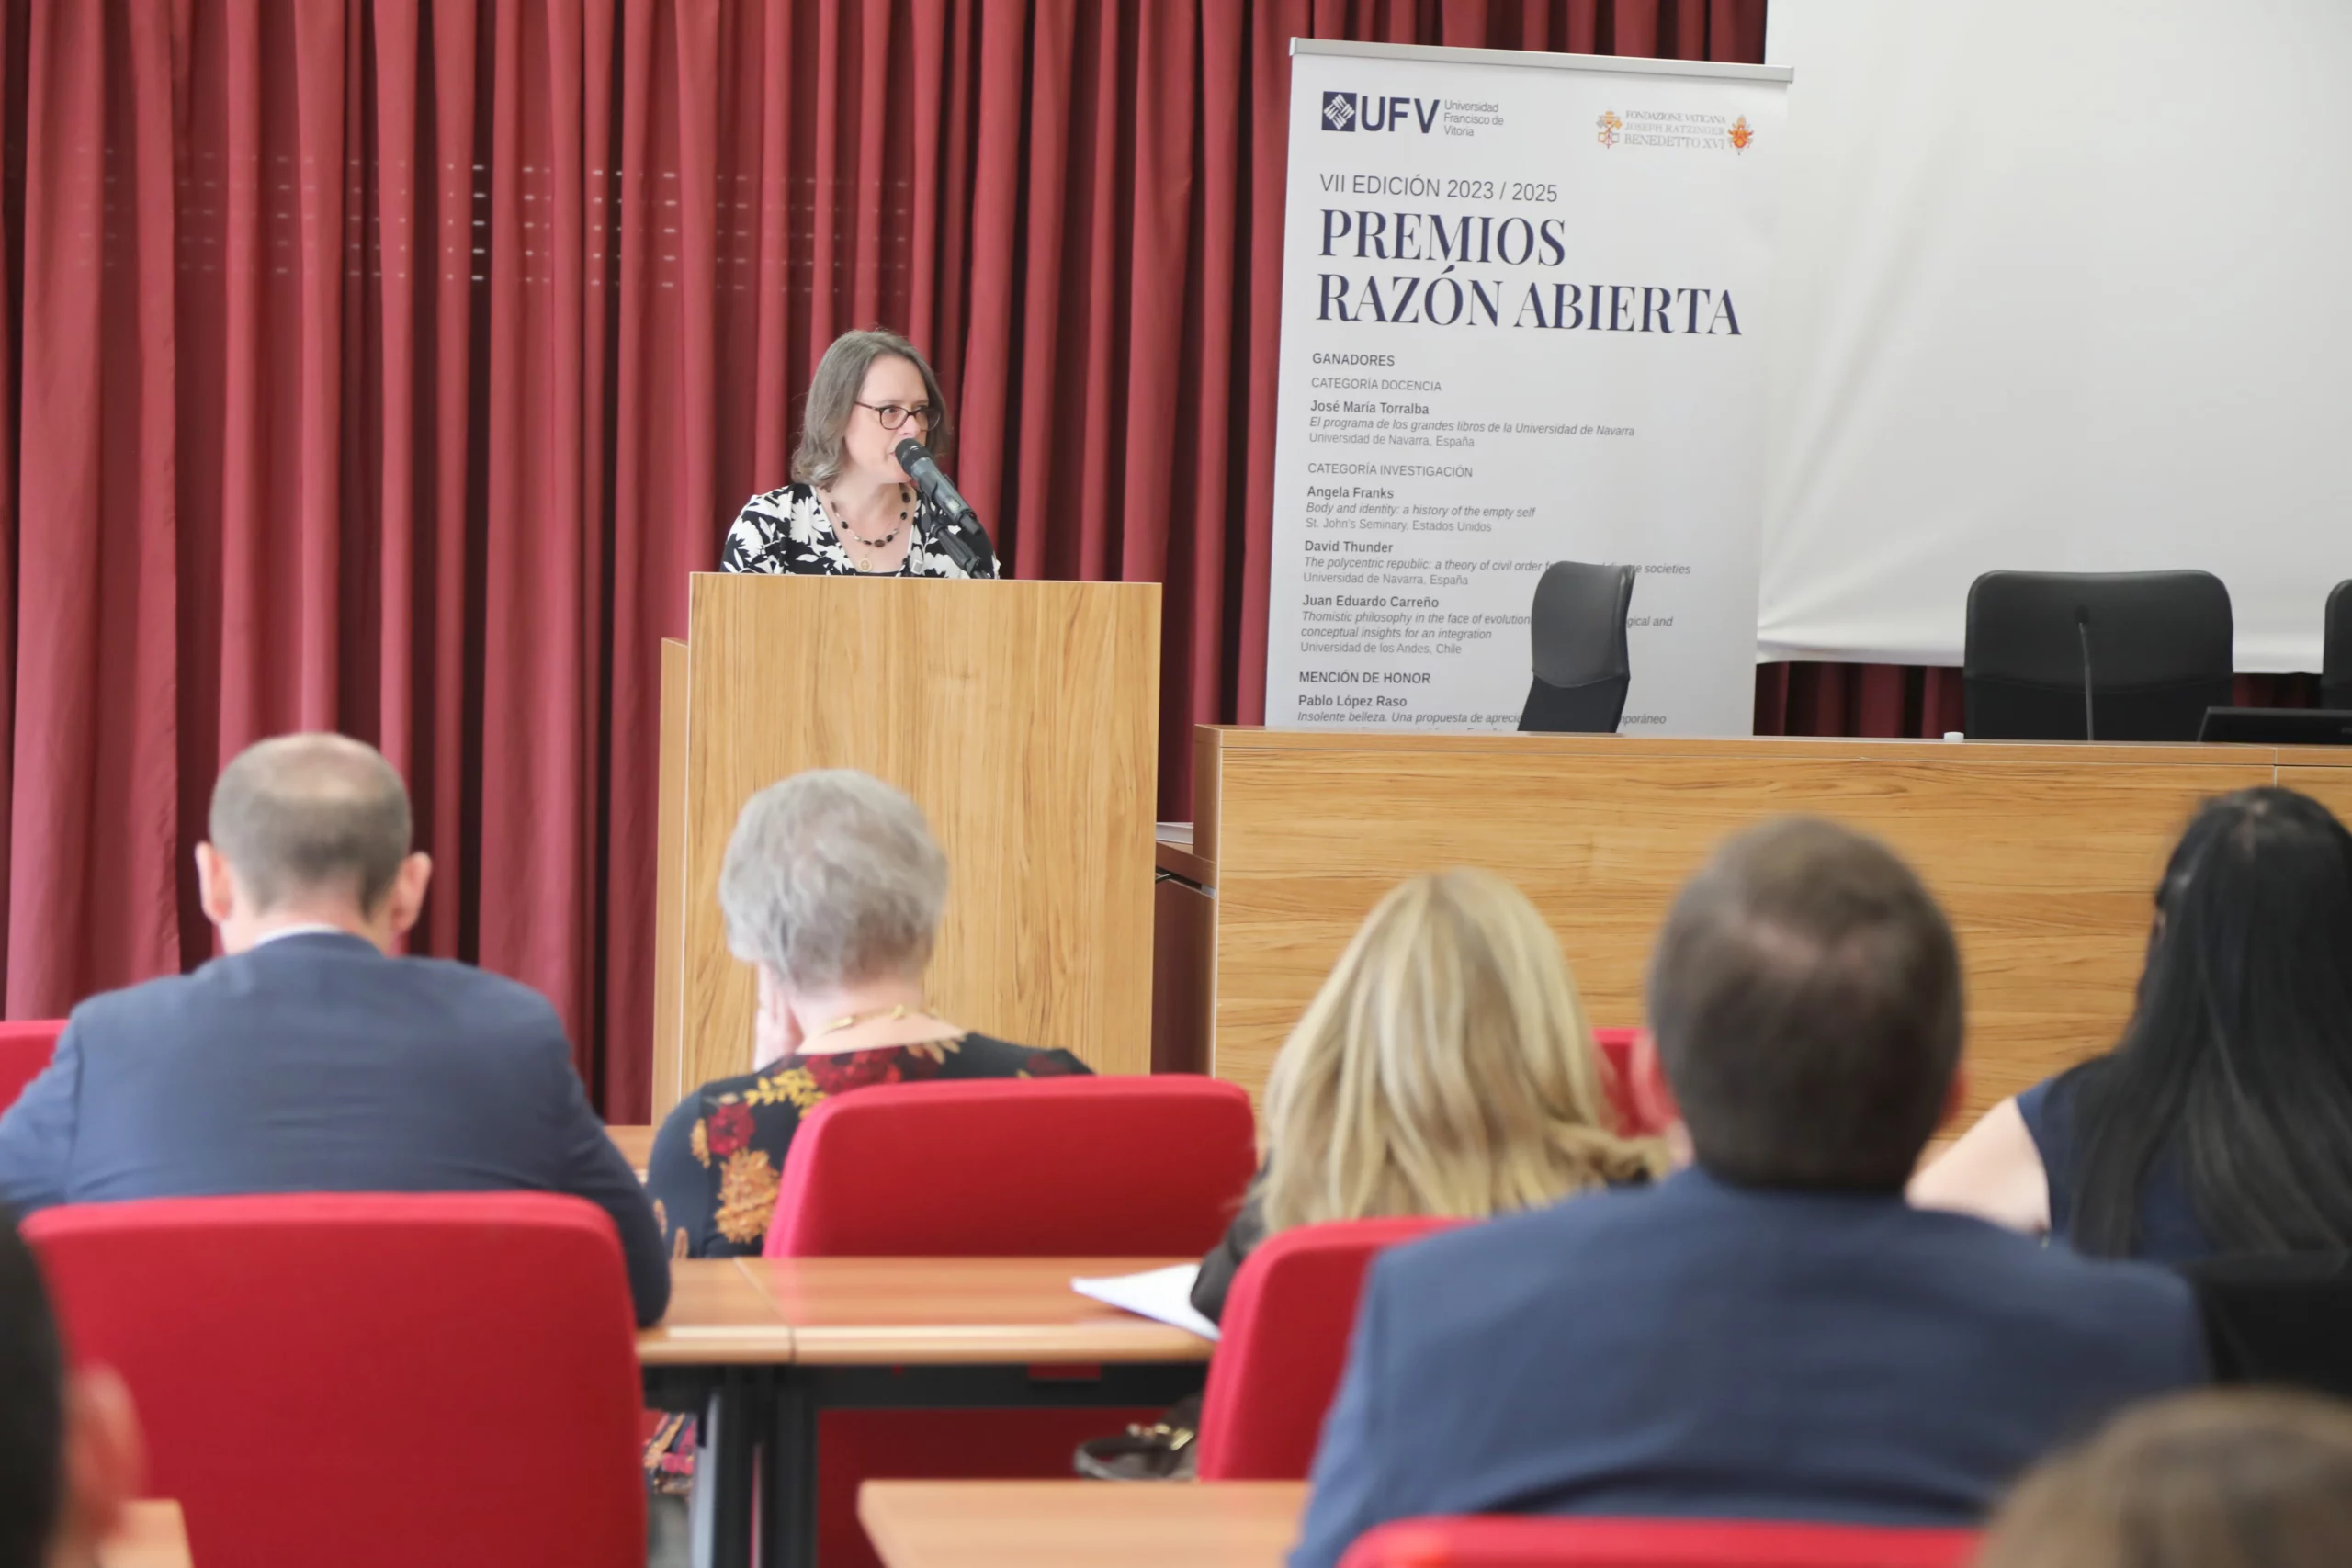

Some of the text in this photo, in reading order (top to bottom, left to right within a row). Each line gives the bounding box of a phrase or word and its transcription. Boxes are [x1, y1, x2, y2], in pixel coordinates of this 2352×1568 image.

[1444, 99, 1498, 113] Universidad
[1362, 96, 1441, 134] UFV
[1444, 112, 1504, 125] Francisco de
[1626, 110, 1726, 124] FONDAZIONE VATICANA
[1444, 125, 1474, 136] Vitoria
[1625, 122, 1724, 136] JOSEPH RATZINGER
[1624, 134, 1724, 150] BENEDETTO XVI
[1320, 174, 1557, 202] VII EDICIÓN 2023 / 2025
[1319, 209, 1565, 266] PREMIOS
[1317, 265, 1742, 335] RAZÓN ABIERTA
[1313, 353, 1395, 367] GANADORES
[1312, 378, 1442, 391] CATEGORÍA DOCENCIA
[1310, 400, 1430, 414] José María Torralba
[1310, 417, 1634, 436] El programa de los grandes libros de la Universidad de Navarra
[1309, 433, 1370, 444] Universidad
[1373, 434, 1385, 445] de
[1436, 435, 1475, 448] España
[1308, 462, 1473, 478] CATEGORÍA INVESTIGACIÓN
[1307, 486, 1394, 500] Angela Franks
[1306, 502, 1334, 515] Body
[1336, 503, 1357, 513] and
[1412, 504, 1450, 518] history
[1452, 506, 1463, 516] of
[1464, 506, 1480, 516] the
[1483, 508, 1514, 520] empty
[1516, 507, 1536, 518] self
[1413, 520, 1454, 531] Estados
[1457, 522, 1492, 532] Unidos
[1305, 540, 1393, 553] David Thunder
[1305, 557, 1325, 567] The
[1327, 558, 1384, 570] polycentric
[1435, 561, 1442, 570] a
[1444, 559, 1477, 572] theory
[1479, 560, 1491, 570] of
[1492, 560, 1512, 570] civil
[1514, 561, 1543, 571] order
[1645, 565, 1690, 574] societies
[1304, 573, 1363, 583] Universidad
[1367, 573, 1380, 583] de
[1430, 574, 1468, 587] España
[1303, 595, 1439, 608] Juan Eduardo Carreño
[1303, 611, 1352, 622] Thomistic
[1354, 612, 1412, 625] philosophy
[1415, 614, 1425, 623] in
[1428, 614, 1444, 624] the
[1448, 614, 1470, 624] face
[1472, 614, 1483, 625] of
[1484, 614, 1532, 626] evolution
[1653, 617, 1674, 626] and
[1301, 627, 1492, 641] conceptual insights for an integration
[1301, 642, 1362, 653] Universidad
[1363, 643, 1376, 653] de
[1380, 643, 1395, 653] los
[1436, 643, 1462, 654] Chile
[1299, 670, 1430, 683] MENCIÓN DE HONOR
[1299, 695, 1408, 709] Pablo López Raso
[1297, 711, 1346, 722] Insolente
[1392, 713, 1413, 722] Una
[1415, 714, 1468, 725] propuesta
[1470, 713, 1483, 723] de
[1486, 714, 1521, 726] aprecia
